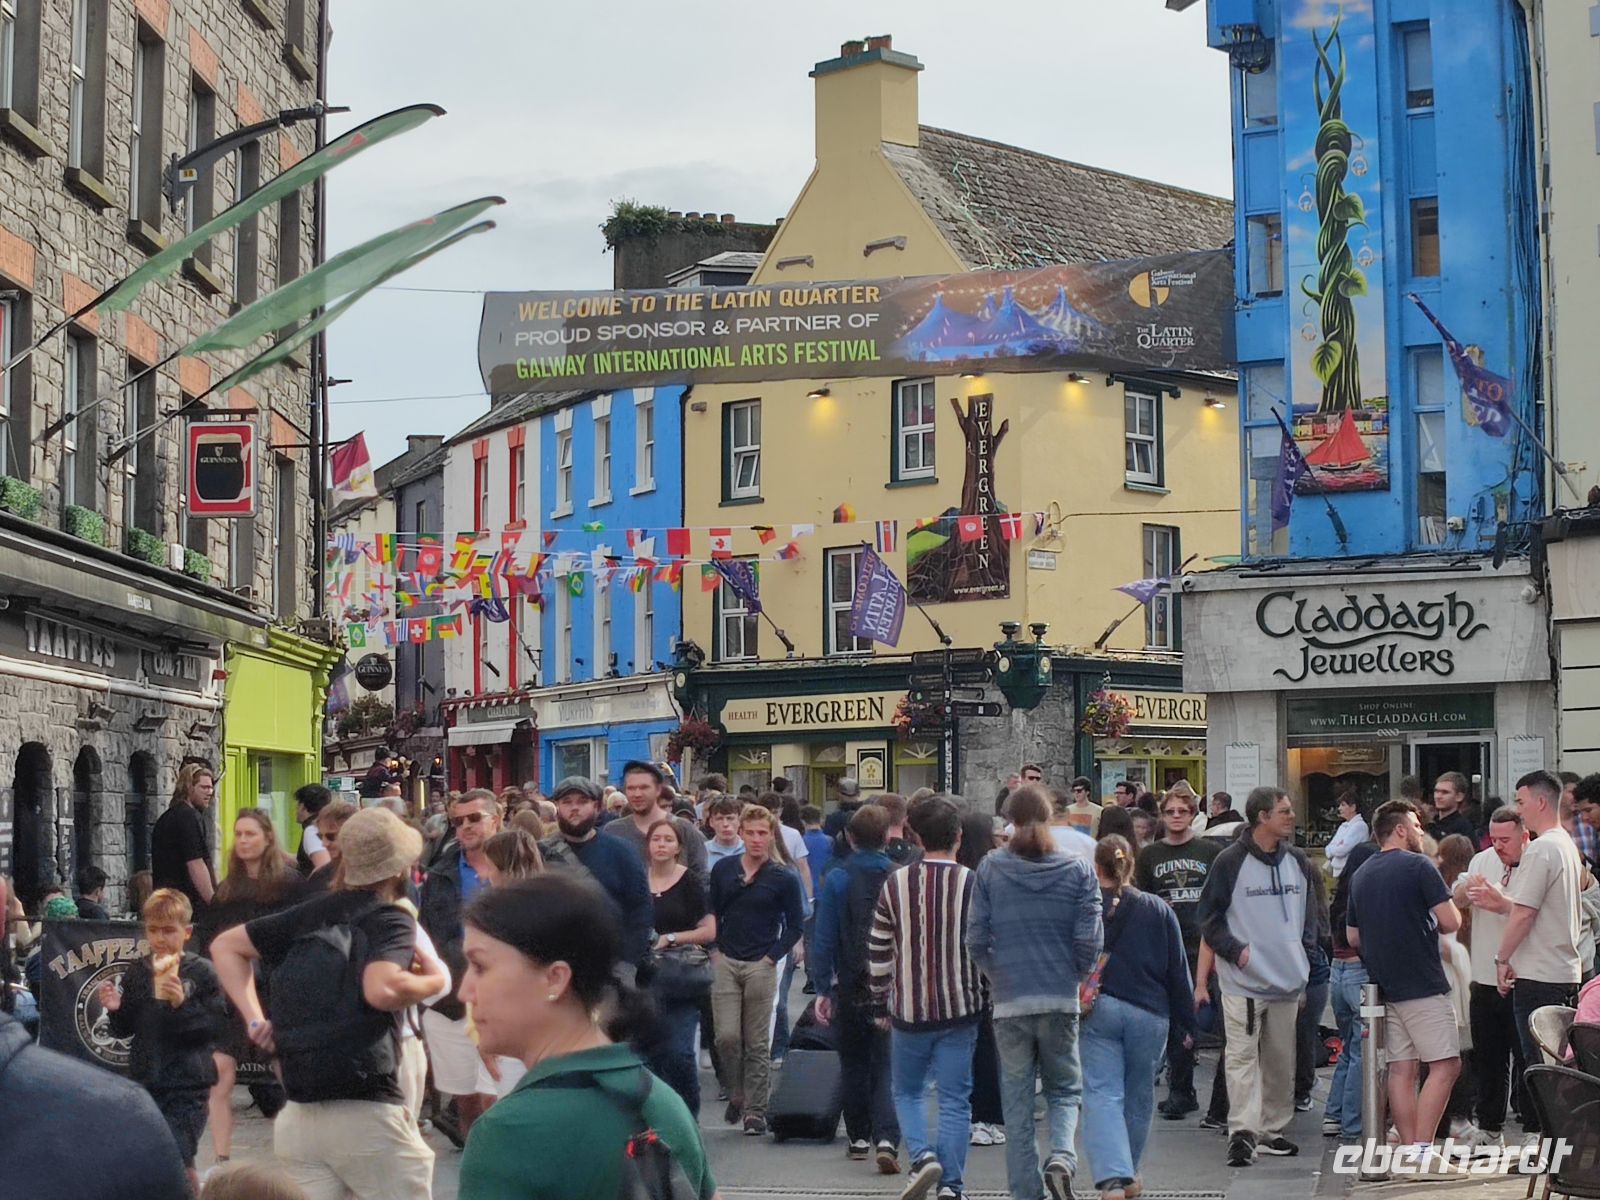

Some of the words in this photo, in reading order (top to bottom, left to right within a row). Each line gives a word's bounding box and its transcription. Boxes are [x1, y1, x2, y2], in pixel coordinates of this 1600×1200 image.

[518, 297, 622, 322] WELCOME
[631, 296, 656, 314] TO
[663, 293, 704, 313] THE
[711, 289, 772, 310] LATIN
[779, 286, 882, 307] QUARTER
[515, 327, 591, 346] PROUD
[597, 321, 706, 341] SPONSOR
[712, 319, 730, 336] &
[736, 314, 842, 334] PARTNER
[848, 313, 880, 328] OF
[1136, 333, 1196, 349] QUARTER
[1150, 323, 1194, 337] LATIN
[516, 353, 587, 380] GALWAY
[594, 345, 736, 375] INTERNATIONAL
[740, 342, 788, 367] ARTS
[794, 339, 881, 364] FESTIVAL
[978, 401, 990, 569] EVERGREEN
[1255, 590, 1490, 649] Claddagh
[357, 664, 391, 673] GUINNESS
[1273, 643, 1455, 682] Jewellers
[728, 711, 758, 721] HEALTH
[766, 697, 884, 726] EVERGREEN
[1135, 695, 1207, 721] EVERGR
[1359, 703, 1380, 711] SHOP
[1154, 858, 1207, 878] GUINNESS
